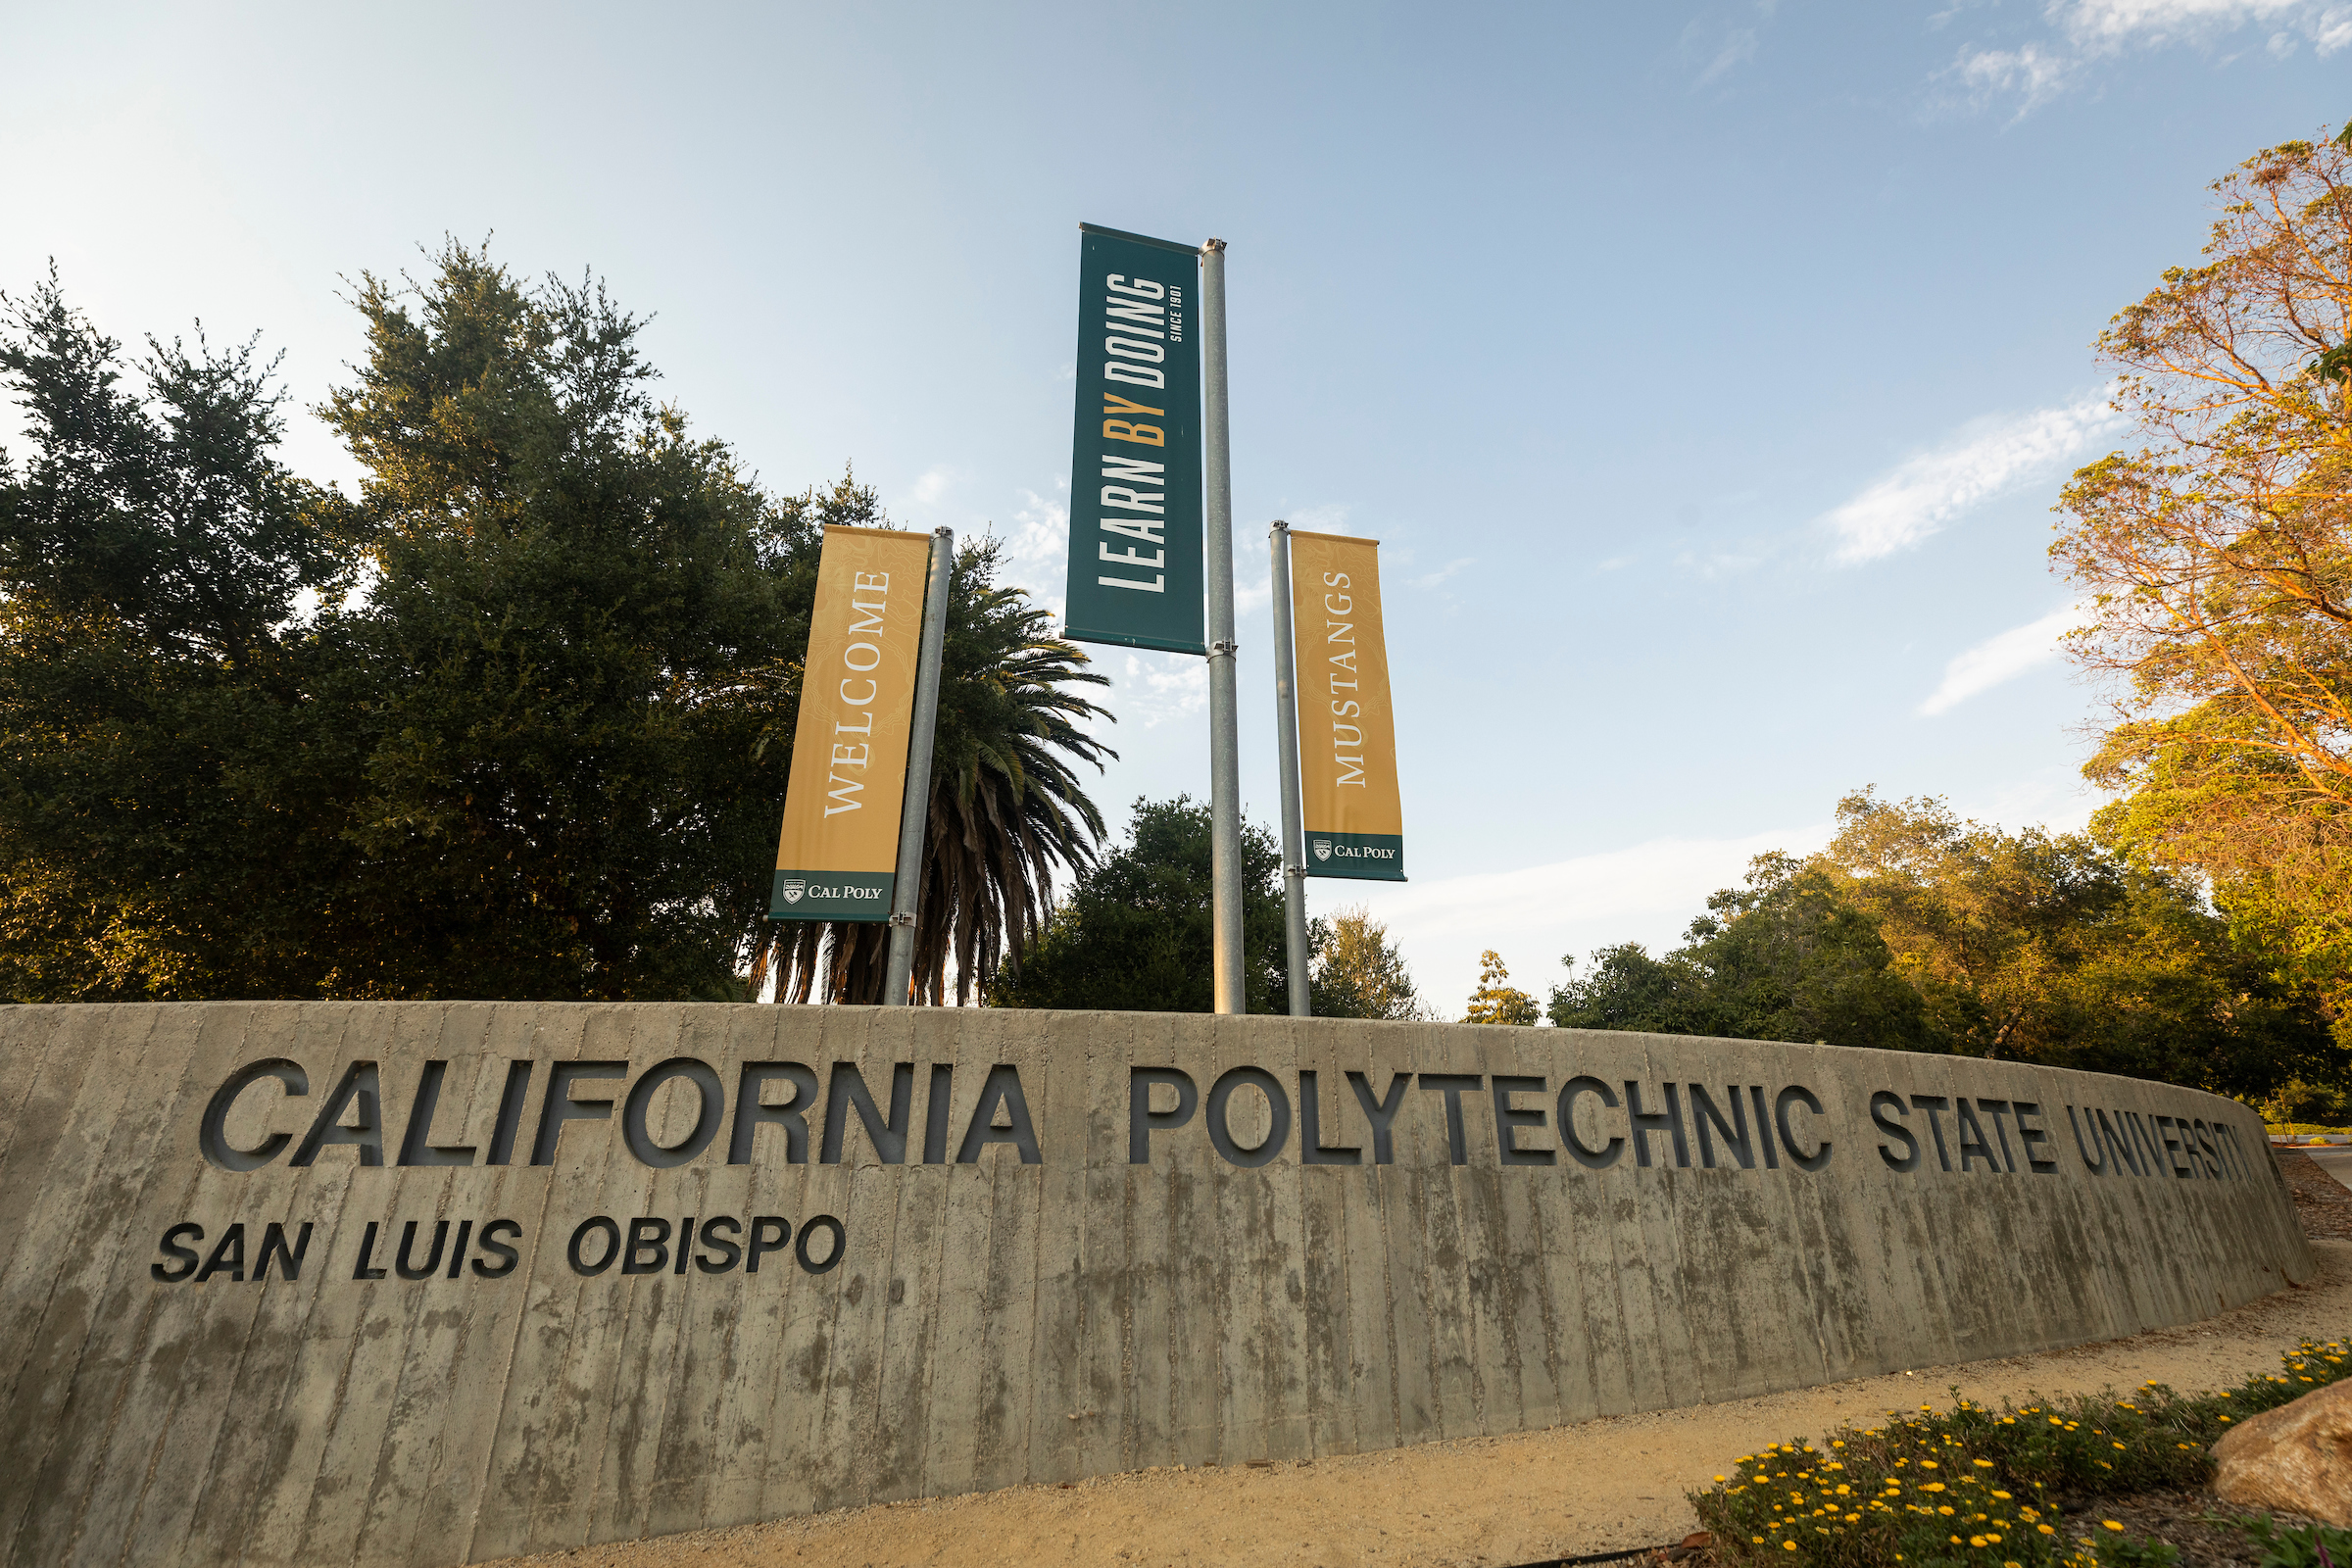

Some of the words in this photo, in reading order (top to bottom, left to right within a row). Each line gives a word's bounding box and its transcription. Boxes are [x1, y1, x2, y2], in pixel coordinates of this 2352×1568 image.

[1103, 272, 1165, 390] DOING
[1169, 284, 1182, 308] 1901
[1169, 311, 1182, 343] SINCE
[1102, 391, 1165, 448] BY
[1098, 454, 1165, 593] LEARN
[823, 570, 890, 818] WELCOME
[1324, 571, 1366, 789] MUSTANGS
[199, 1055, 1043, 1172] CALIFORNIA
[1129, 1064, 1833, 1173] POLYTECHNIC
[1870, 1090, 2057, 1174] STATE
[2066, 1104, 2253, 1182] UNIVERSITY
[150, 1220, 315, 1284] SAN
[352, 1218, 523, 1282] LUIS
[566, 1214, 847, 1277] OBISPO
